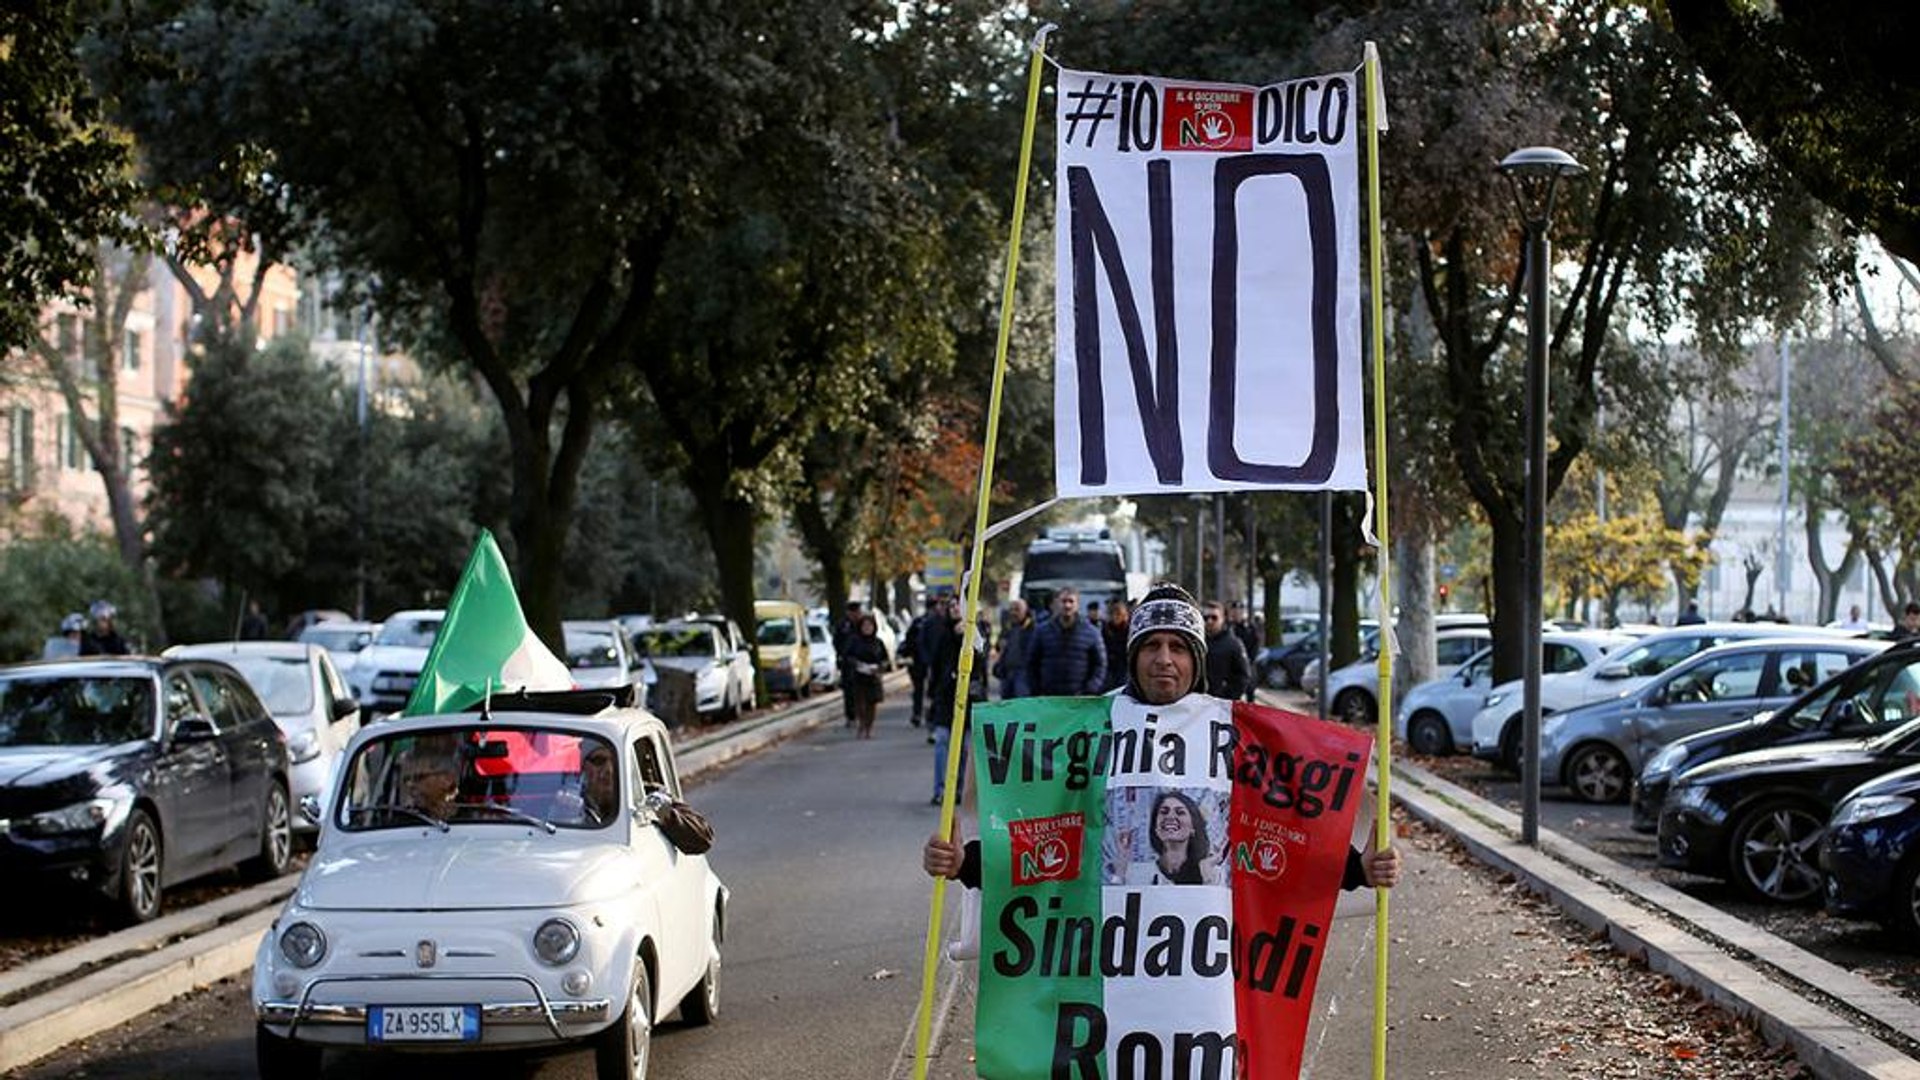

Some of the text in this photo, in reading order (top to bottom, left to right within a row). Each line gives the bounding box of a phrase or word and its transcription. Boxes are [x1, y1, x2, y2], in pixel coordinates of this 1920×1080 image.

[1065, 77, 1350, 151] #IO DICO
[1067, 153, 1340, 486] NO
[982, 713, 1360, 818] Virginia Raggi
[992, 892, 1320, 999] Sindaco di
[384, 1011, 461, 1034] ZA 955LX
